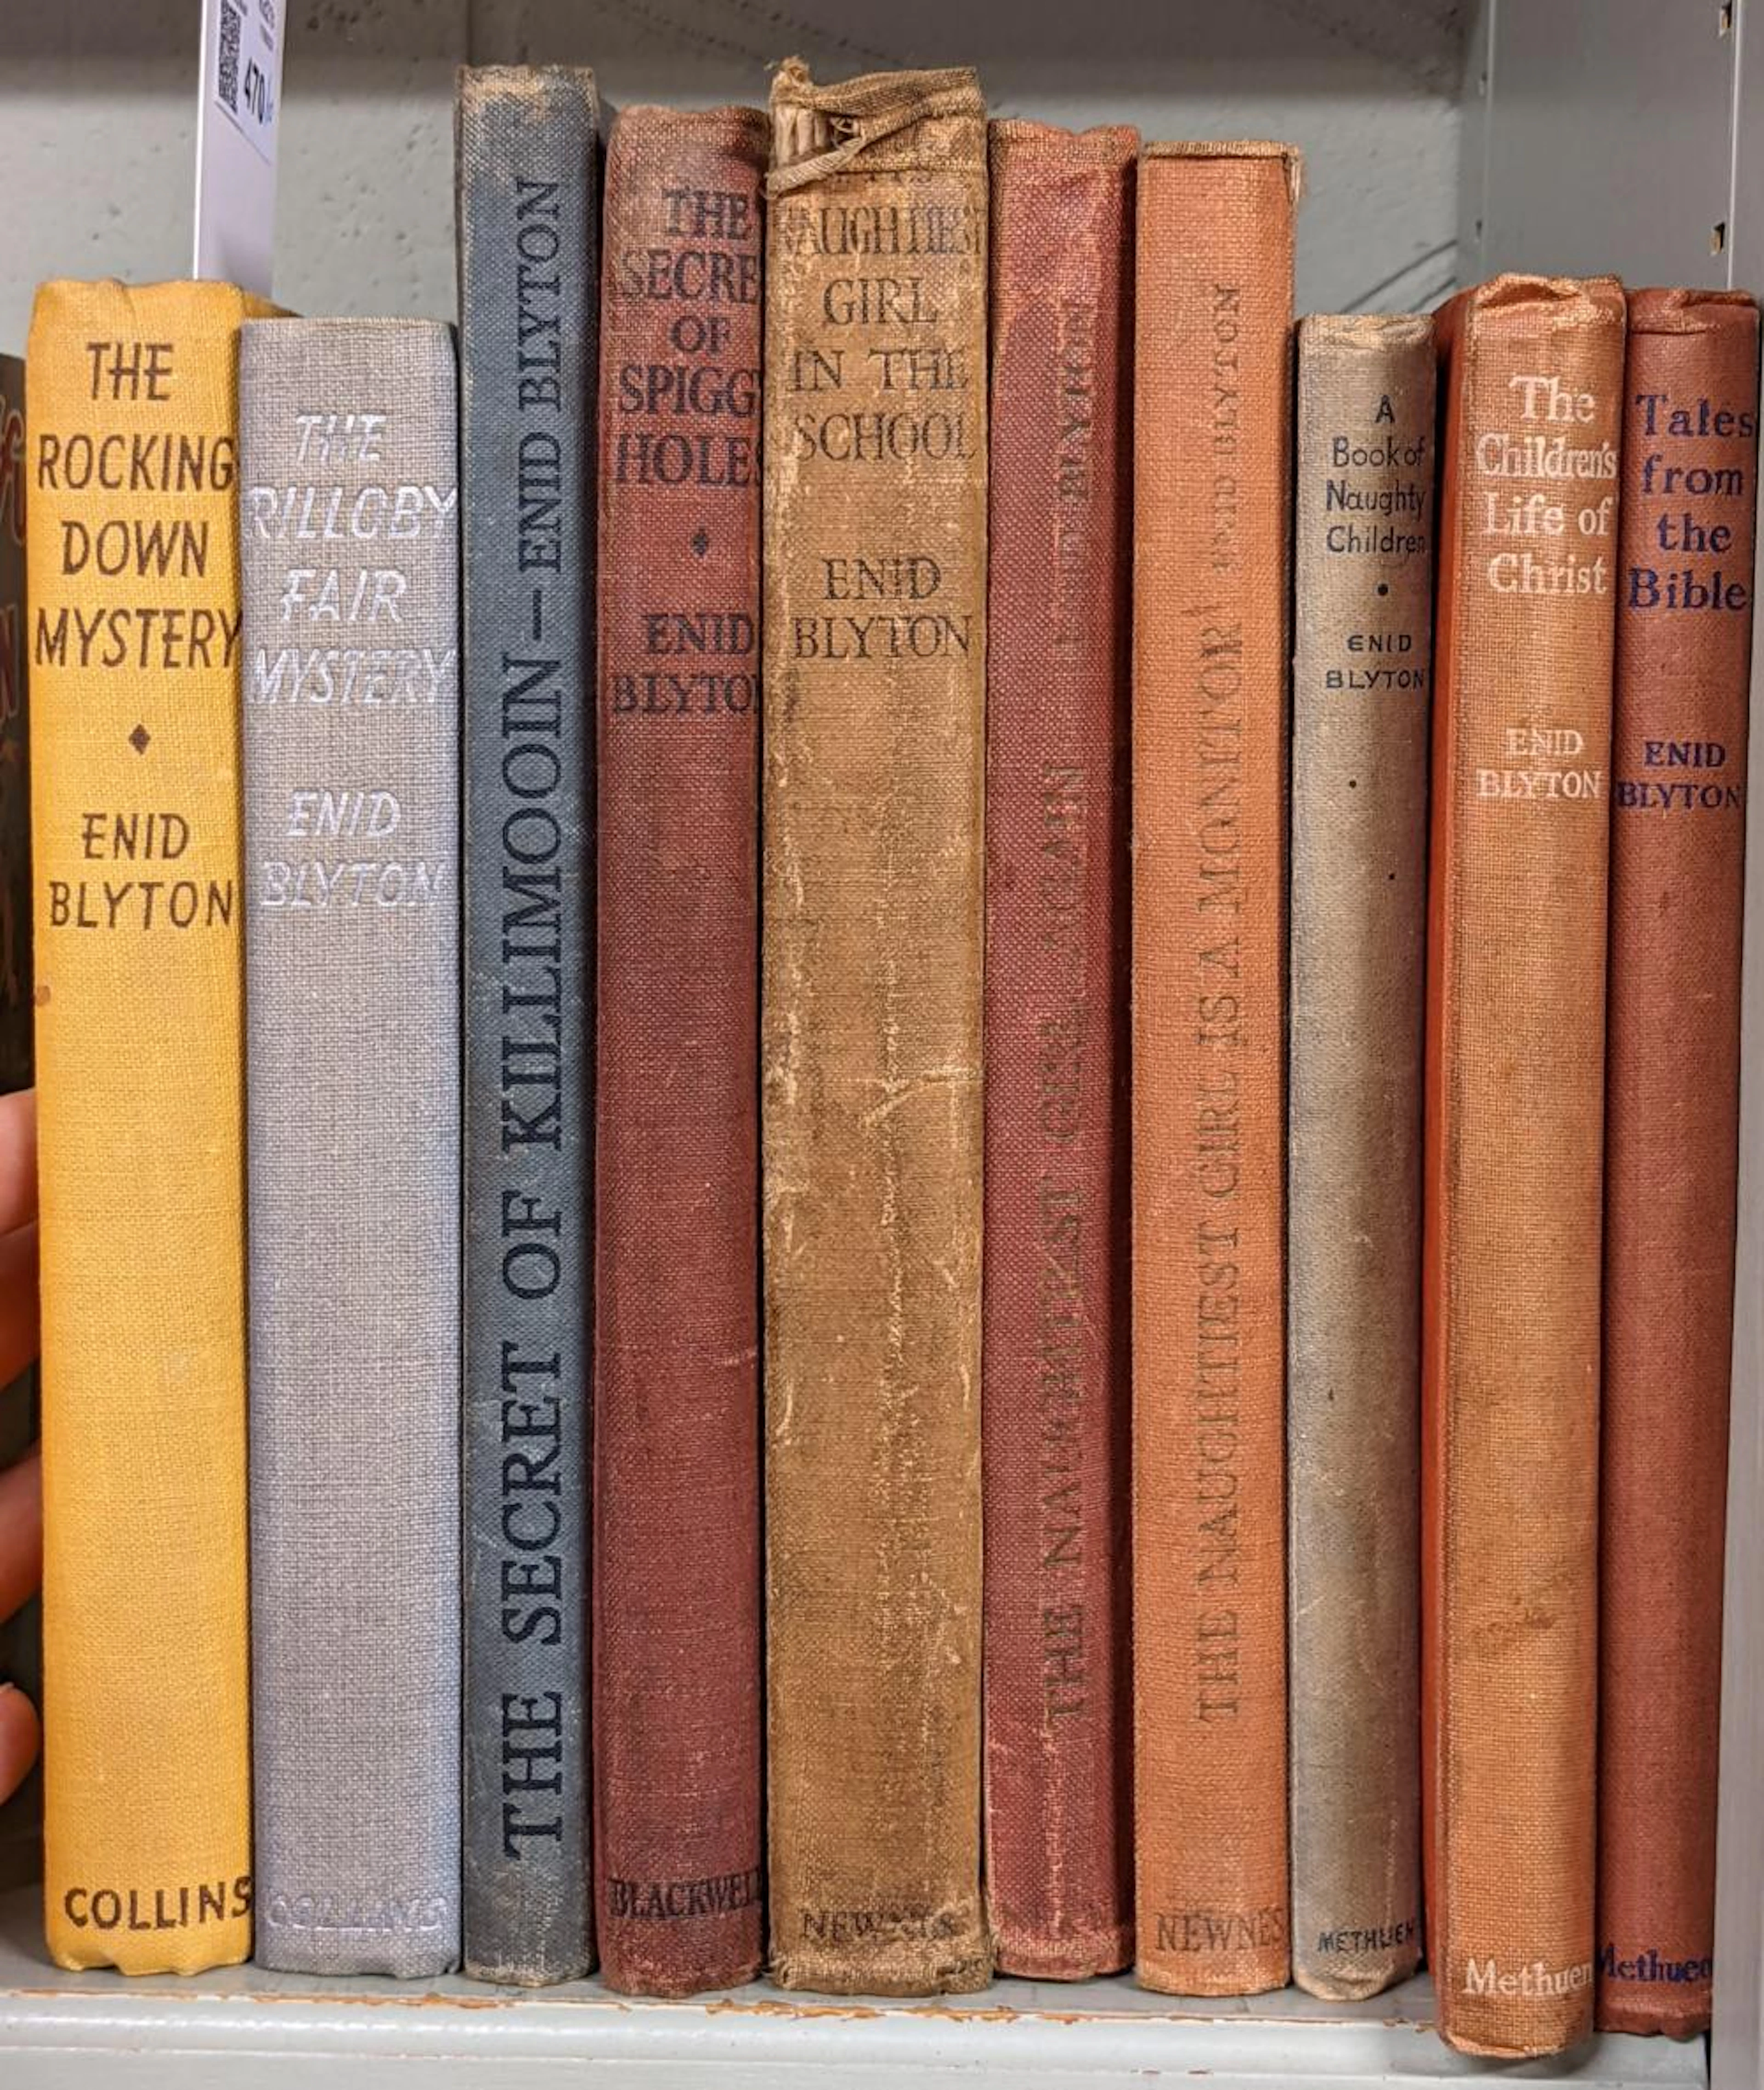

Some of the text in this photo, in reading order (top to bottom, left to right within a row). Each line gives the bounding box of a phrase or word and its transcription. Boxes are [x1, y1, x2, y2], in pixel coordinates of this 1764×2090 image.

[662, 189, 750, 239] THE
[515, 176, 561, 413] BLYTON
[622, 249, 758, 304] SECRE
[825, 278, 939, 324] GIRL
[670, 316, 730, 354] OF
[86, 342, 173, 401] THE
[618, 366, 758, 416] SPIGG
[788, 349, 967, 392] IN THE
[1211, 283, 1239, 459] BLYTON
[1375, 395, 1394, 423] A
[1509, 375, 1595, 423] The
[1636, 394, 1755, 437] Tales
[296, 414, 387, 463] THE
[616, 434, 761, 486] HOLE
[794, 412, 976, 461] SCHOOL
[1334, 437, 1425, 467] Book of
[1476, 433, 1617, 479] Children's
[39, 434, 238, 492] ROCKING
[1641, 454, 1744, 496] from
[518, 432, 561, 573] ENID
[1326, 480, 1425, 521] Naughty
[1482, 491, 1613, 536] Life of
[62, 520, 208, 577] DOWN
[1327, 525, 1425, 552] Children
[1657, 513, 1733, 553] the
[282, 568, 407, 623] FAIR
[821, 558, 941, 600] ENID
[1487, 553, 1607, 594] Christ
[1628, 567, 1747, 611] Bible
[36, 608, 241, 669] MYSTERY
[641, 613, 754, 655] ENID
[792, 615, 973, 659] BLYTON
[1347, 635, 1412, 652] ENID
[247, 648, 456, 705] MYSTERY
[614, 672, 758, 713] BLYTO
[1326, 670, 1423, 689] BLYTON
[1506, 729, 1583, 756] ENID
[1644, 741, 1726, 768] ENID
[1197, 621, 1243, 913] MONITOR
[1476, 769, 1602, 798] BLYTON
[287, 790, 400, 837] ENID
[1617, 781, 1741, 810] BLYTON
[82, 813, 189, 860] ENID
[49, 881, 232, 930] BLYTON
[260, 861, 447, 906] BLYTON
[502, 653, 561, 1152] KILLIMOOIN
[1197, 935, 1240, 980] A
[1195, 993, 1241, 1049] IS
[1196, 1068, 1241, 1199] GIRL
[503, 1192, 562, 1300] OF
[1194, 1220, 1239, 1586] NAUGHTIEST
[503, 1341, 562, 1645] SECRET
[1042, 1608, 1085, 1728] THE
[1195, 1610, 1239, 1724] THE
[504, 1690, 563, 1861] THE
[64, 1876, 252, 1930] COLLINS
[1155, 1905, 1284, 1952] NEWNES
[1318, 1918, 1413, 1952] METHUEN
[1462, 1958, 1594, 1996] Methuen
